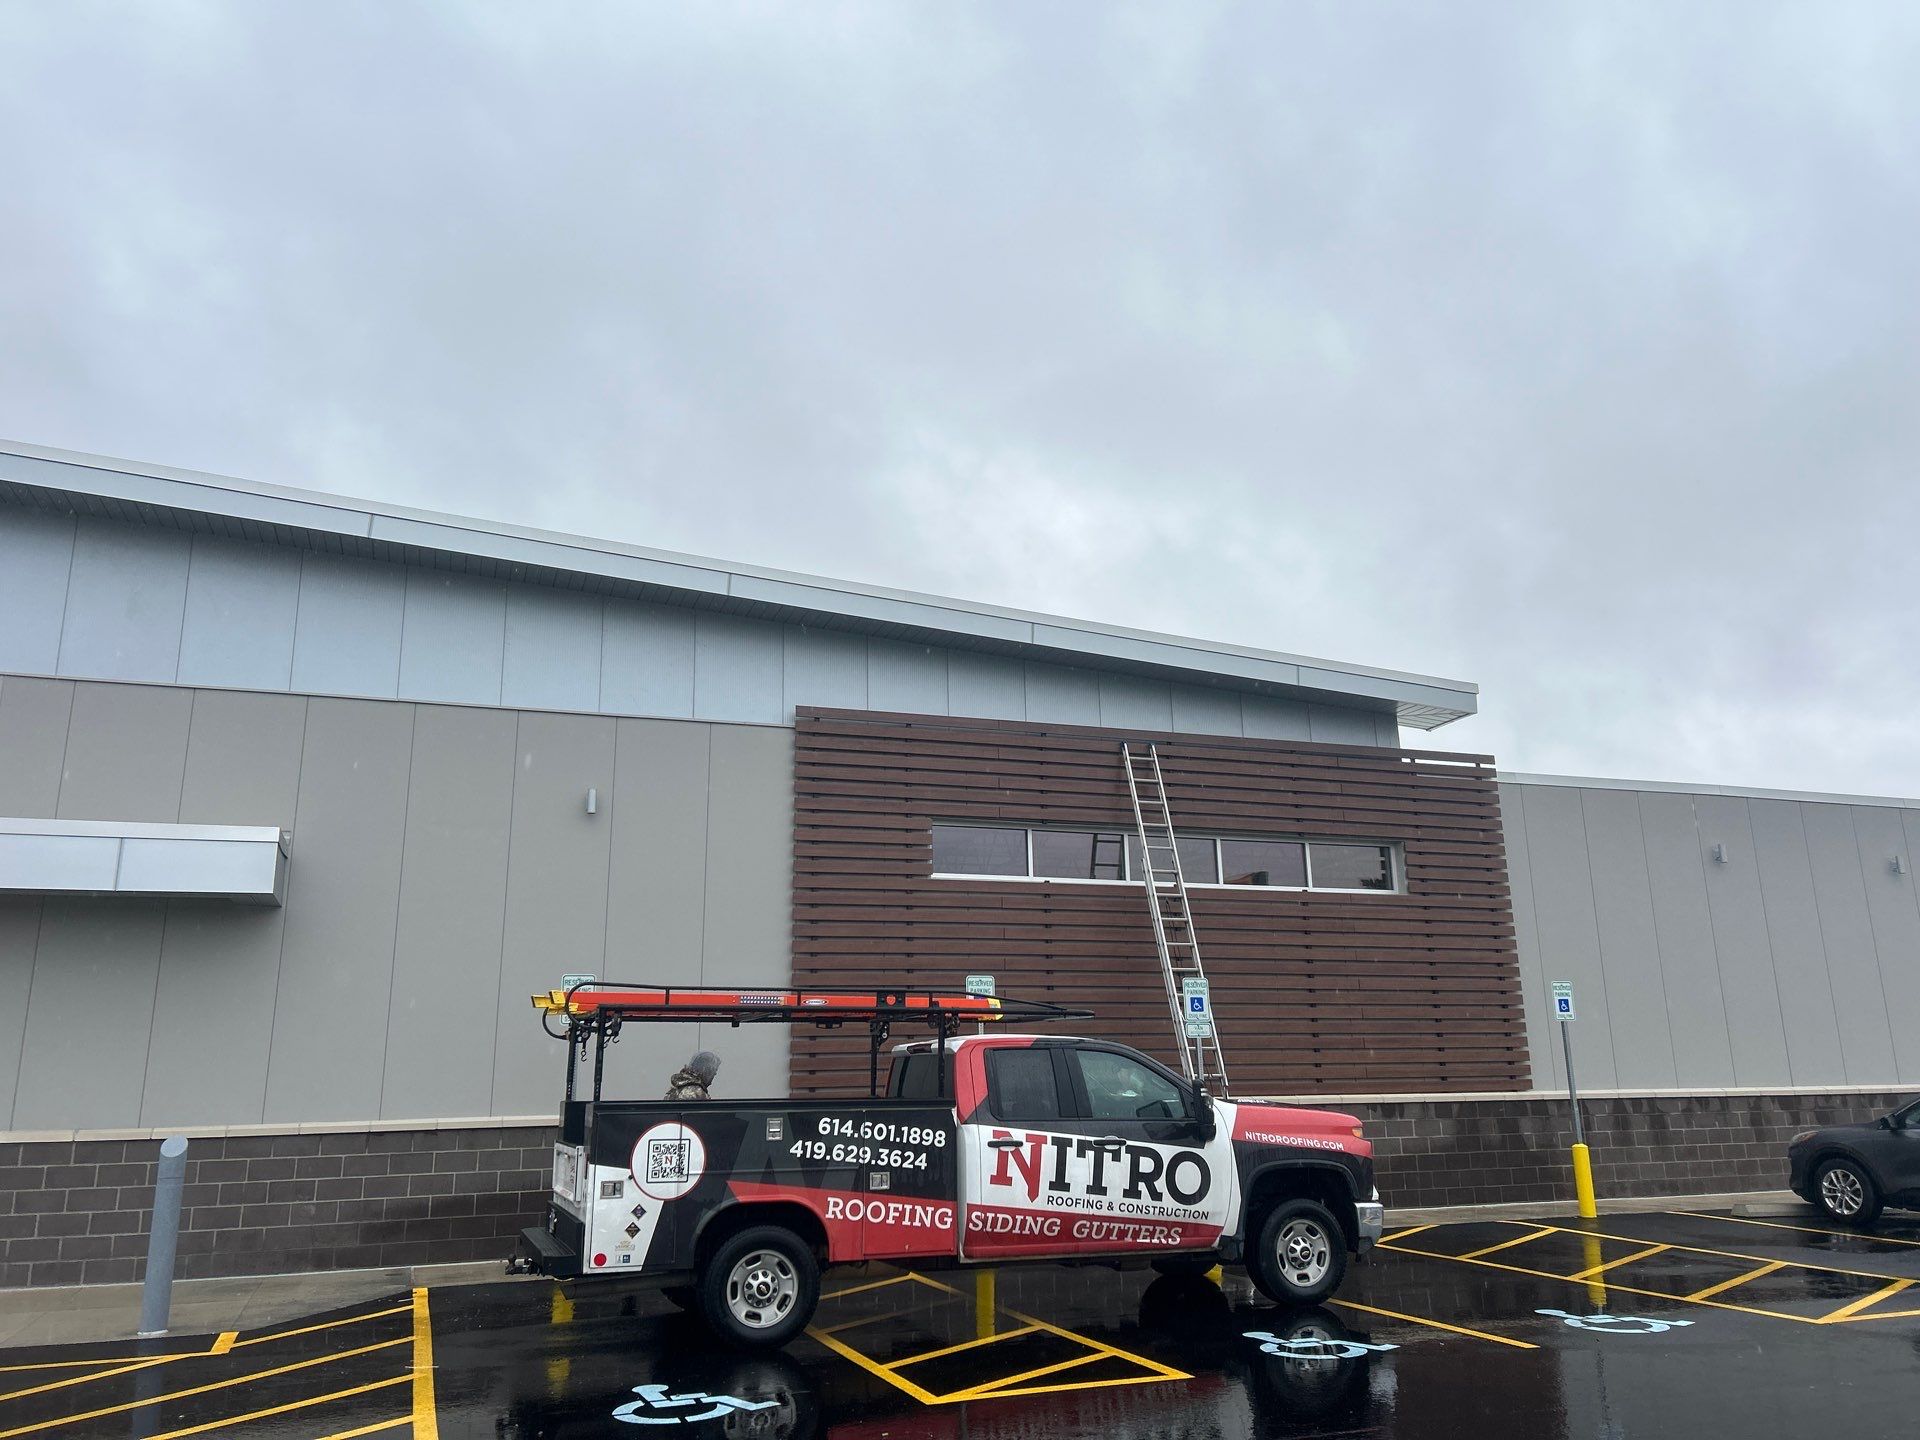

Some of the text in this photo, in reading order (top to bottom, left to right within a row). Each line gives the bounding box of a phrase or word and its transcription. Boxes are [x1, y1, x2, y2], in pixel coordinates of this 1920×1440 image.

[818, 1117, 946, 1147] 614.601.1898
[1245, 1131, 1344, 1151] NITROROOFING.COM
[789, 1140, 928, 1170] 419.629.3624
[989, 1129, 1211, 1206] NITRO
[825, 1196, 953, 1229] ROOFING
[1047, 1195, 1209, 1220] ROOFING & CONSTRUCTION
[968, 1211, 1182, 1245] SIDING GUTTERS
